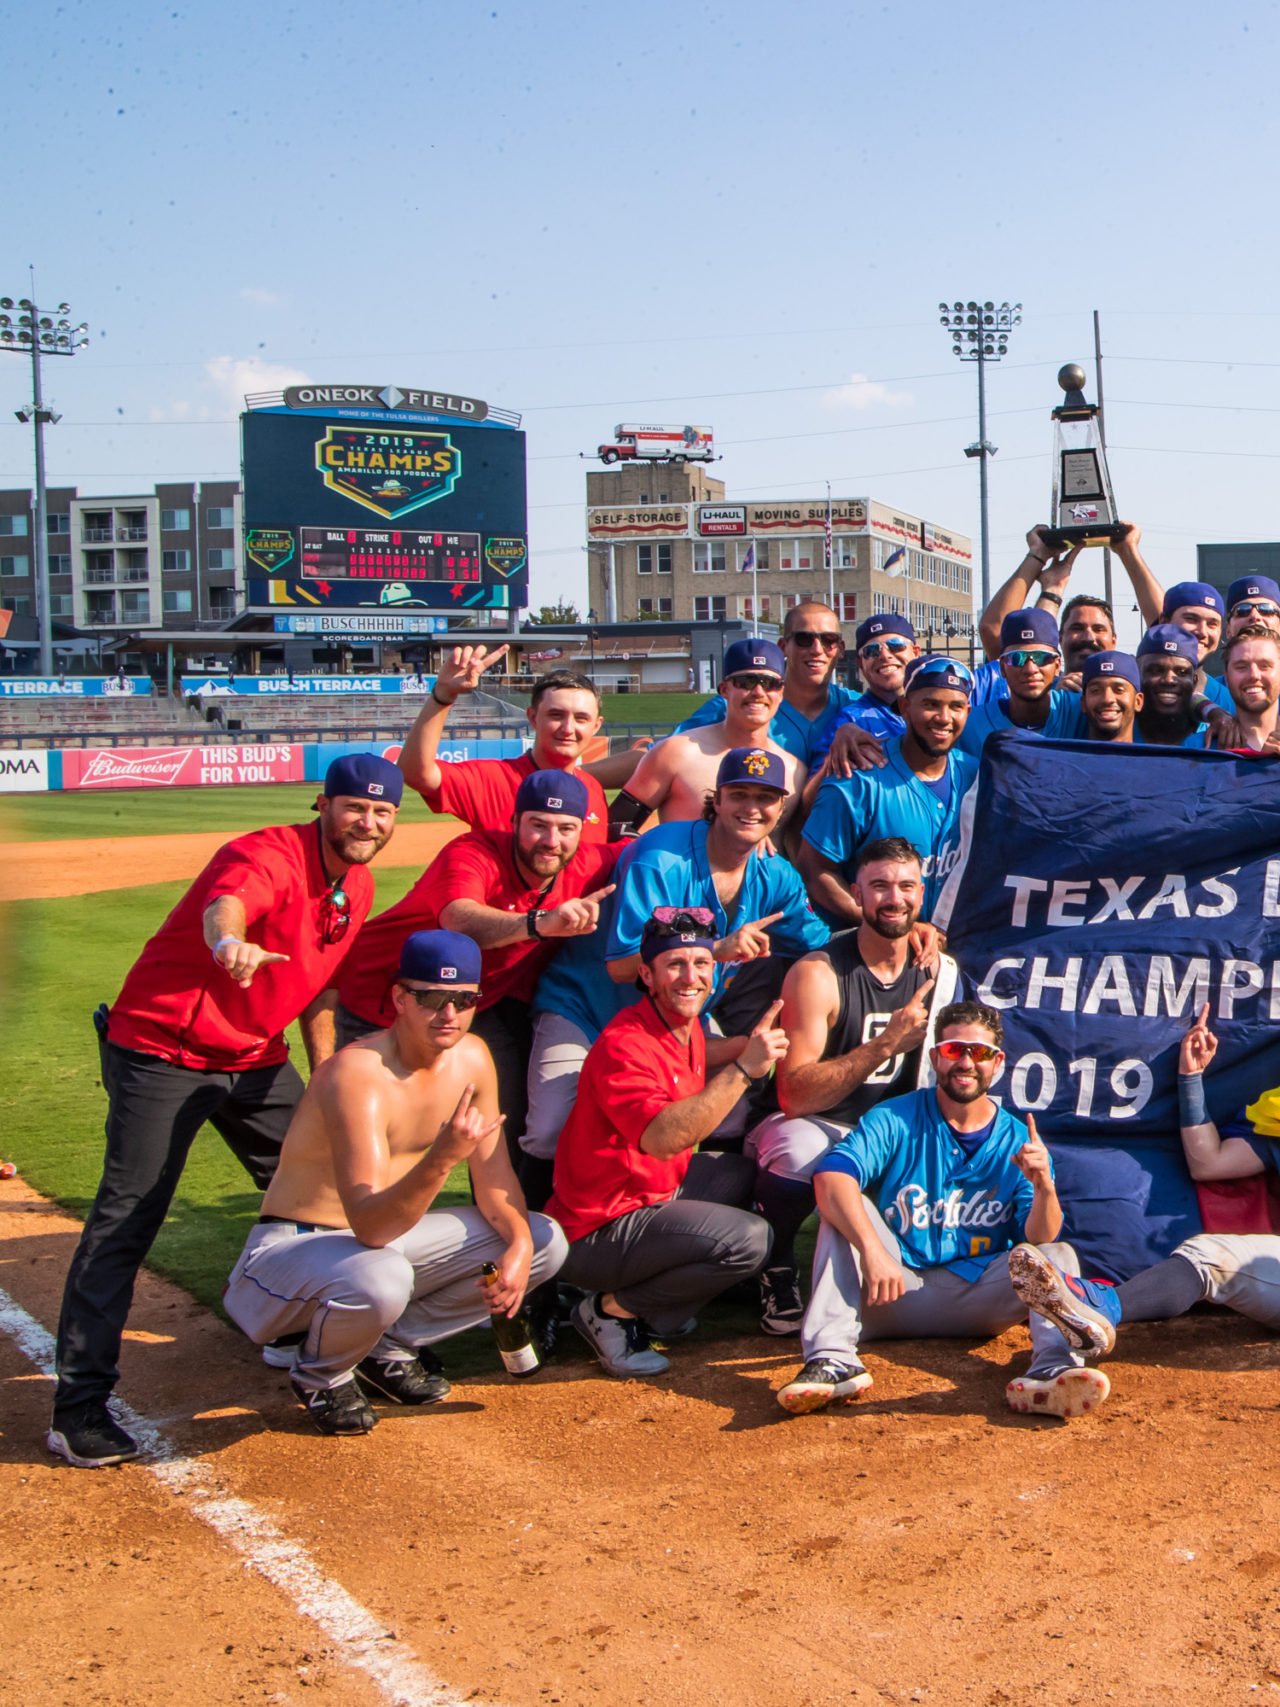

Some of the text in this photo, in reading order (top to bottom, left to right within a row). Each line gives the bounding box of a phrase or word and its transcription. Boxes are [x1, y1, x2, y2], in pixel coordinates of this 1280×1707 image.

[299, 388, 476, 414] ONEOK FIELD
[386, 413, 407, 421] TULSA
[408, 414, 439, 422] DRILLERS
[365, 435, 414, 447] 2019
[325, 445, 451, 472] CHAMPS
[337, 467, 382, 475] AMARILLO
[404, 470, 441, 478] POODLES
[594, 512, 681, 525] SELF-STORAGE
[703, 510, 742, 519] U-HAUL
[754, 507, 863, 520] MOVING SUPLIES
[708, 524, 737, 532] RENTALS
[327, 532, 345, 541] BALL
[365, 533, 389, 542] STRIKE
[418, 535, 432, 544] OUT
[321, 617, 404, 631] BUSCHHHHH
[1, 681, 83, 694] TERRACE
[258, 679, 381, 692] BUSCH TERRACE
[200, 746, 291, 765] THIS BUD'S
[91, 757, 182, 776] Budweiser
[201, 765, 275, 783] FOR YOU.
[1003, 866, 1242, 928] TEXAS
